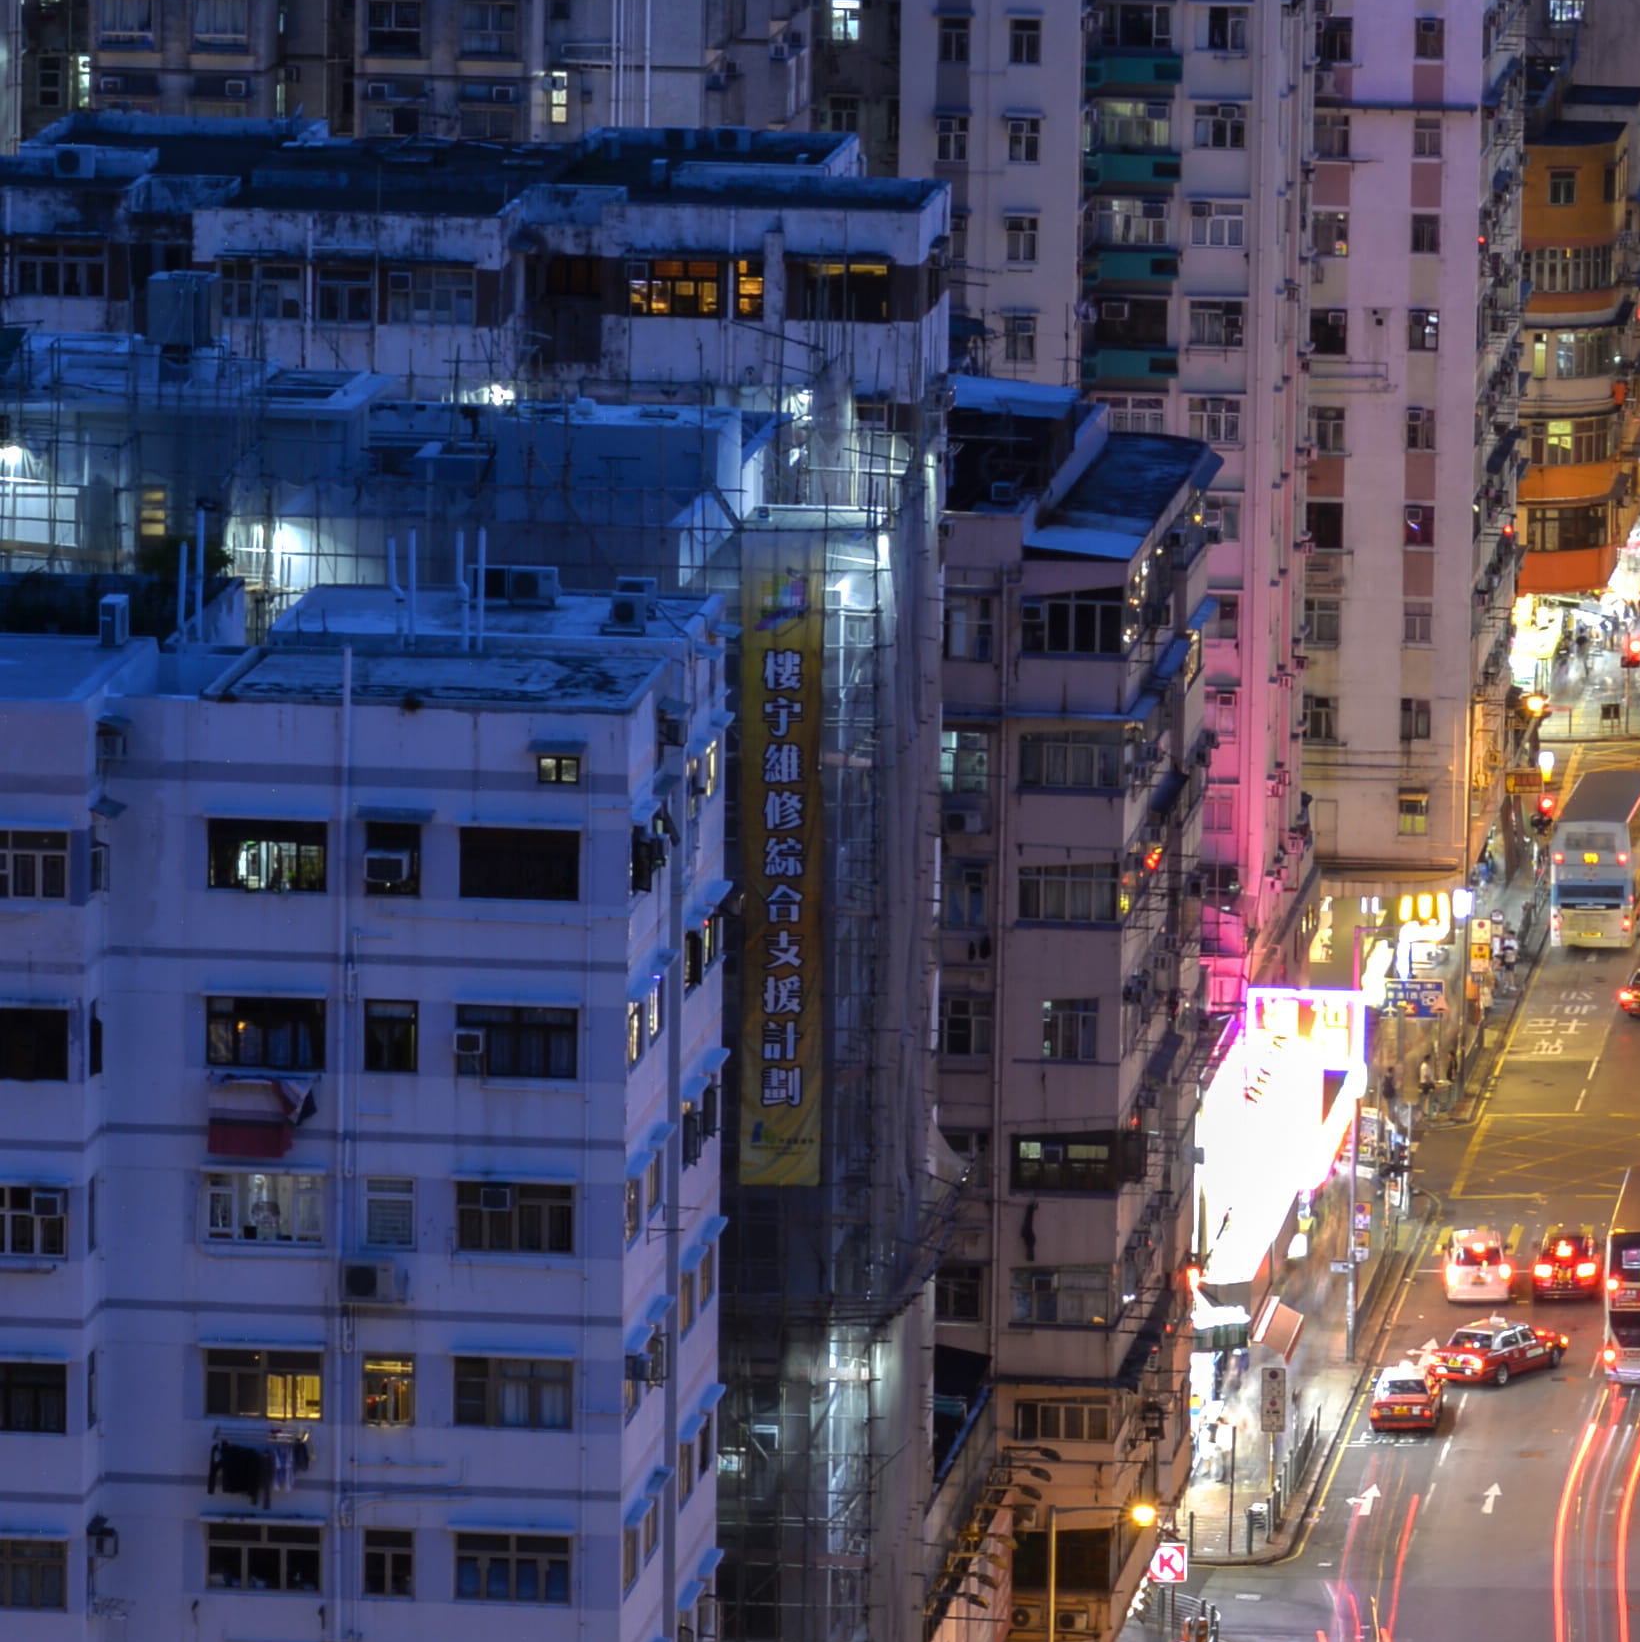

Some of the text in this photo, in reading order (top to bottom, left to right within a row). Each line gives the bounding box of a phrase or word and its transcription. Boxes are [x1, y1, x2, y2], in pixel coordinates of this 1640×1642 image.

[762, 648, 804, 1108] 樓宇維修綜合支援計劃
